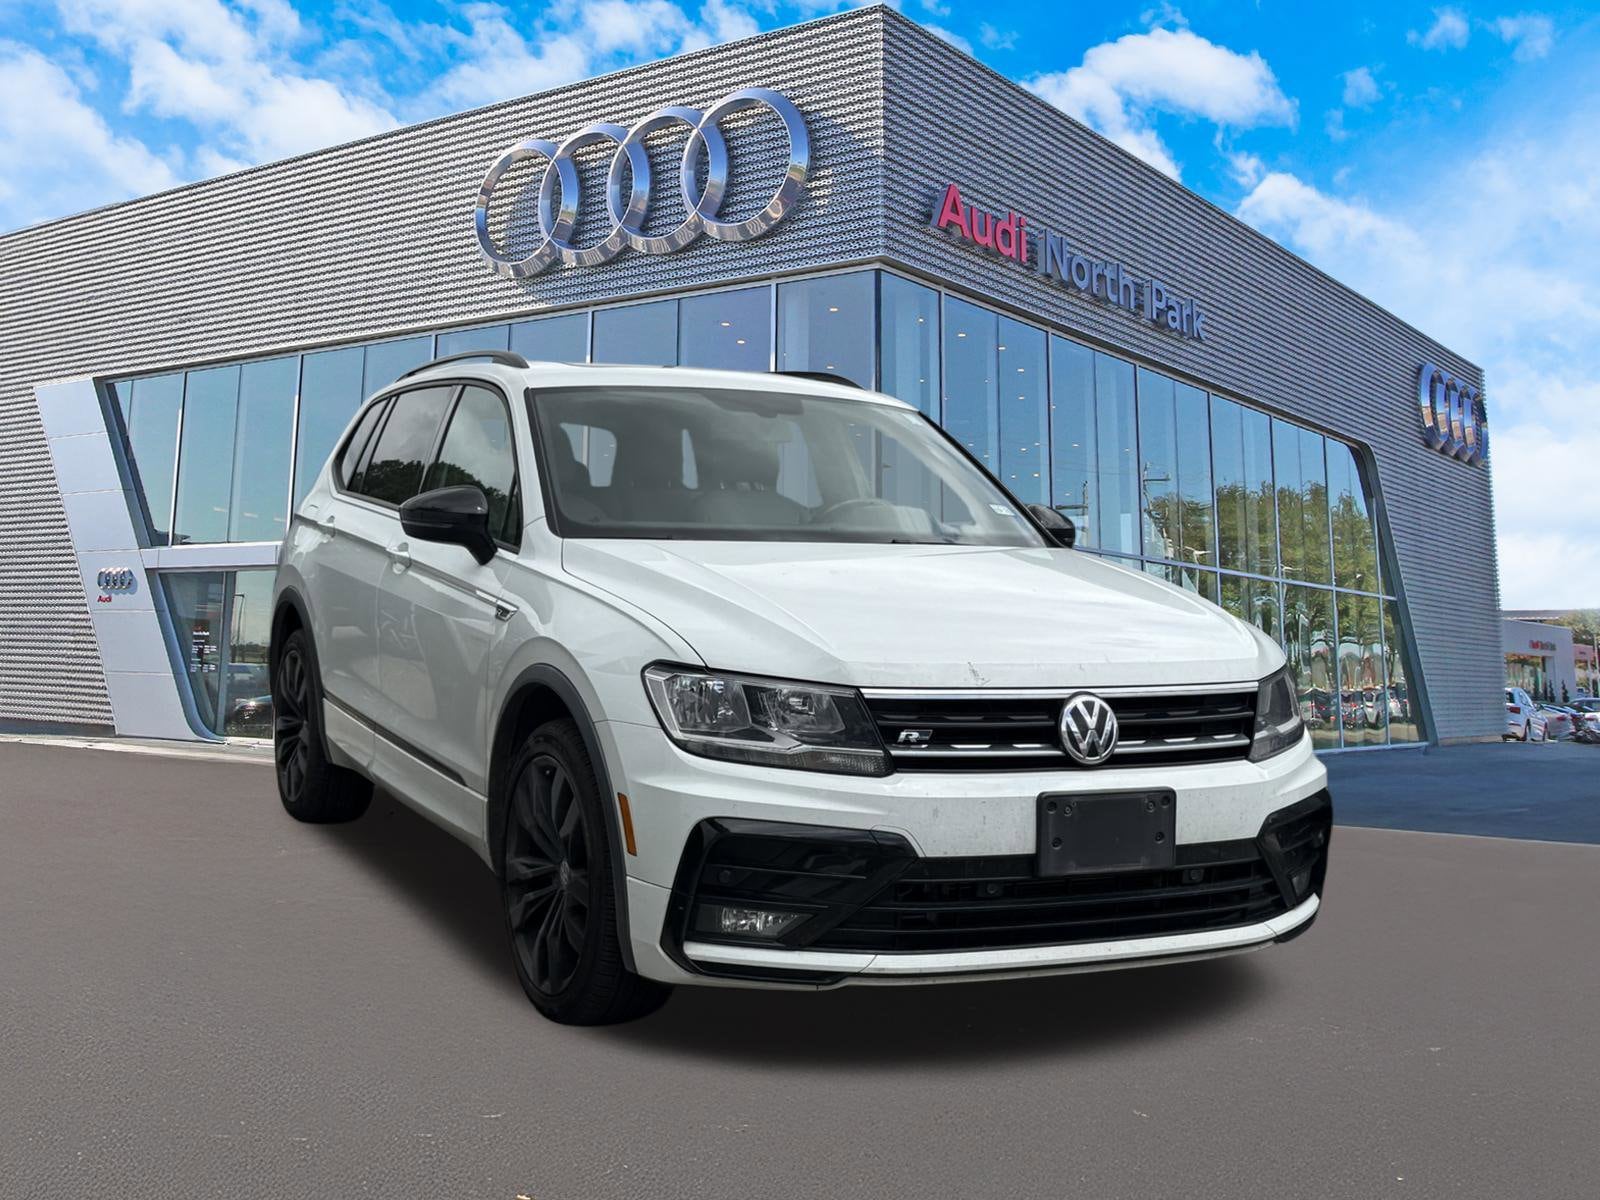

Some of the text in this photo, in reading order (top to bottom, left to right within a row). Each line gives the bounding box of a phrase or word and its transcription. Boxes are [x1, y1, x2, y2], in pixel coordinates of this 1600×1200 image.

[934, 183, 1206, 340] Audi North Park
